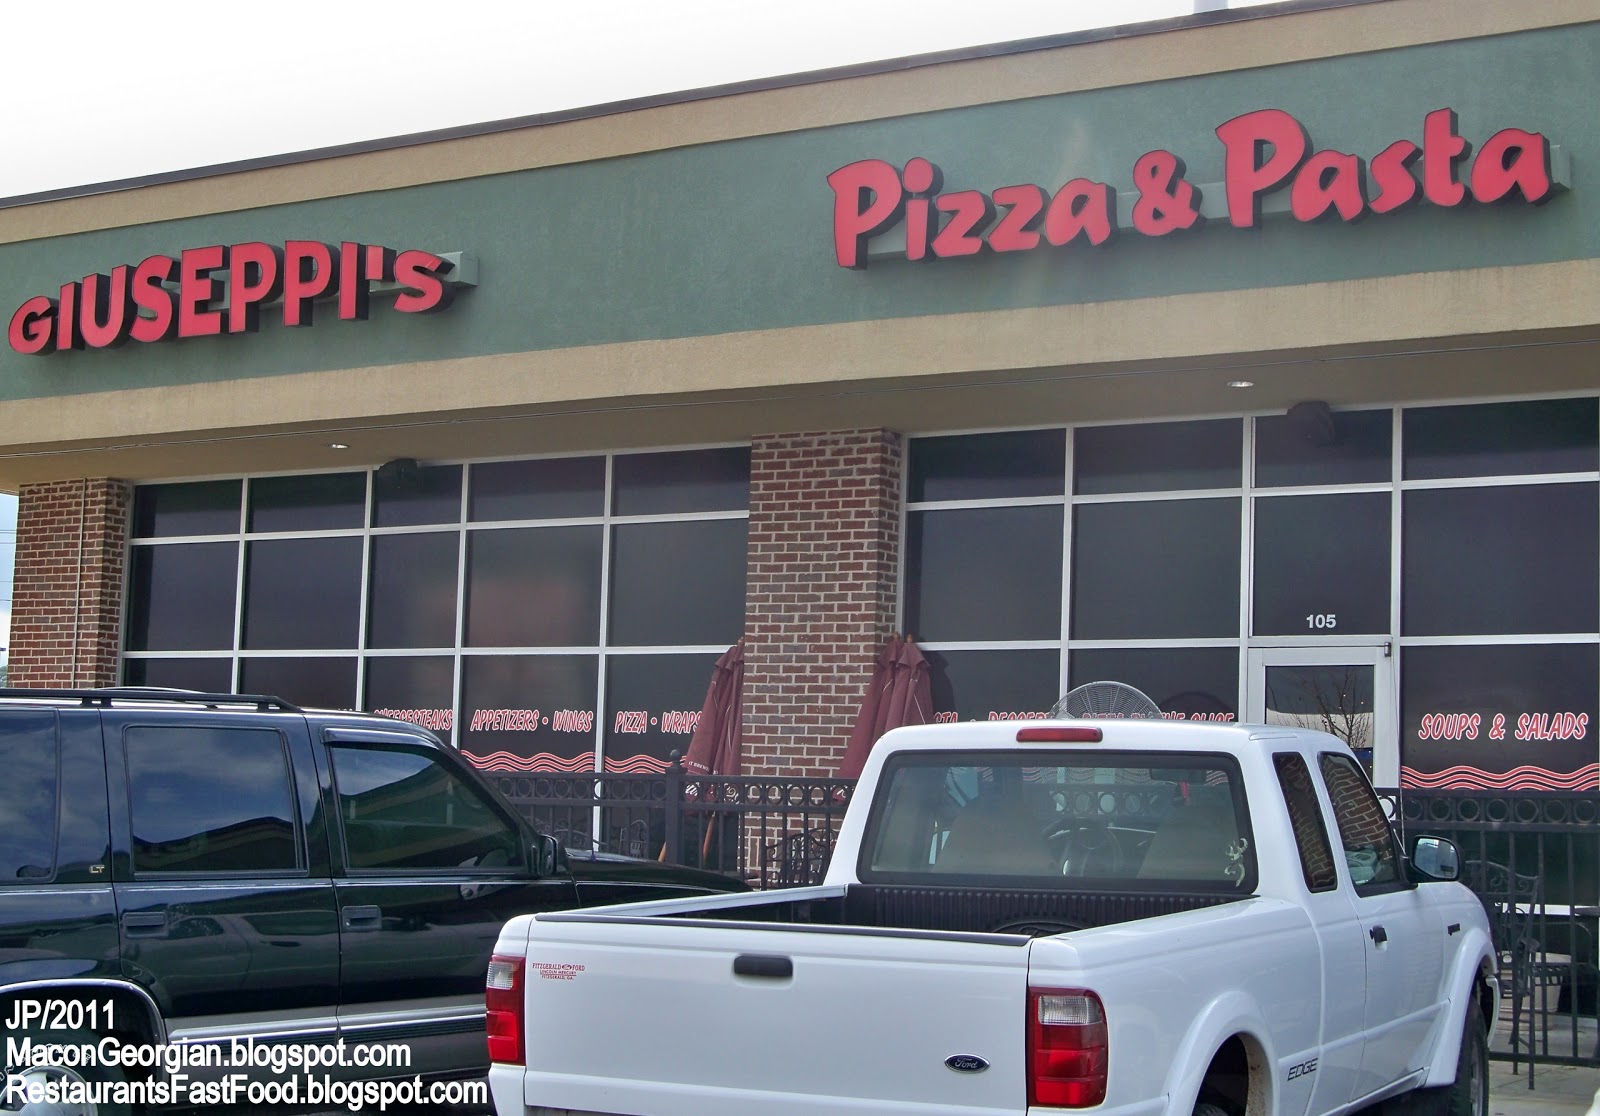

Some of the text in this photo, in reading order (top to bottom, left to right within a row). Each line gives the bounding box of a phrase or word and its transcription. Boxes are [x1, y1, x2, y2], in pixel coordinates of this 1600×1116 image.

[827, 107, 1551, 269] Pizza & Pasta
[7, 239, 455, 355] GIUSEPPI'S
[1306, 614, 1336, 629] 105
[470, 708, 594, 733] APPETIZERS WINGS
[614, 710, 648, 734] PIZZA
[1418, 712, 1589, 741] SOUPS & SALADS
[1287, 1057, 1319, 1081] EDGE
